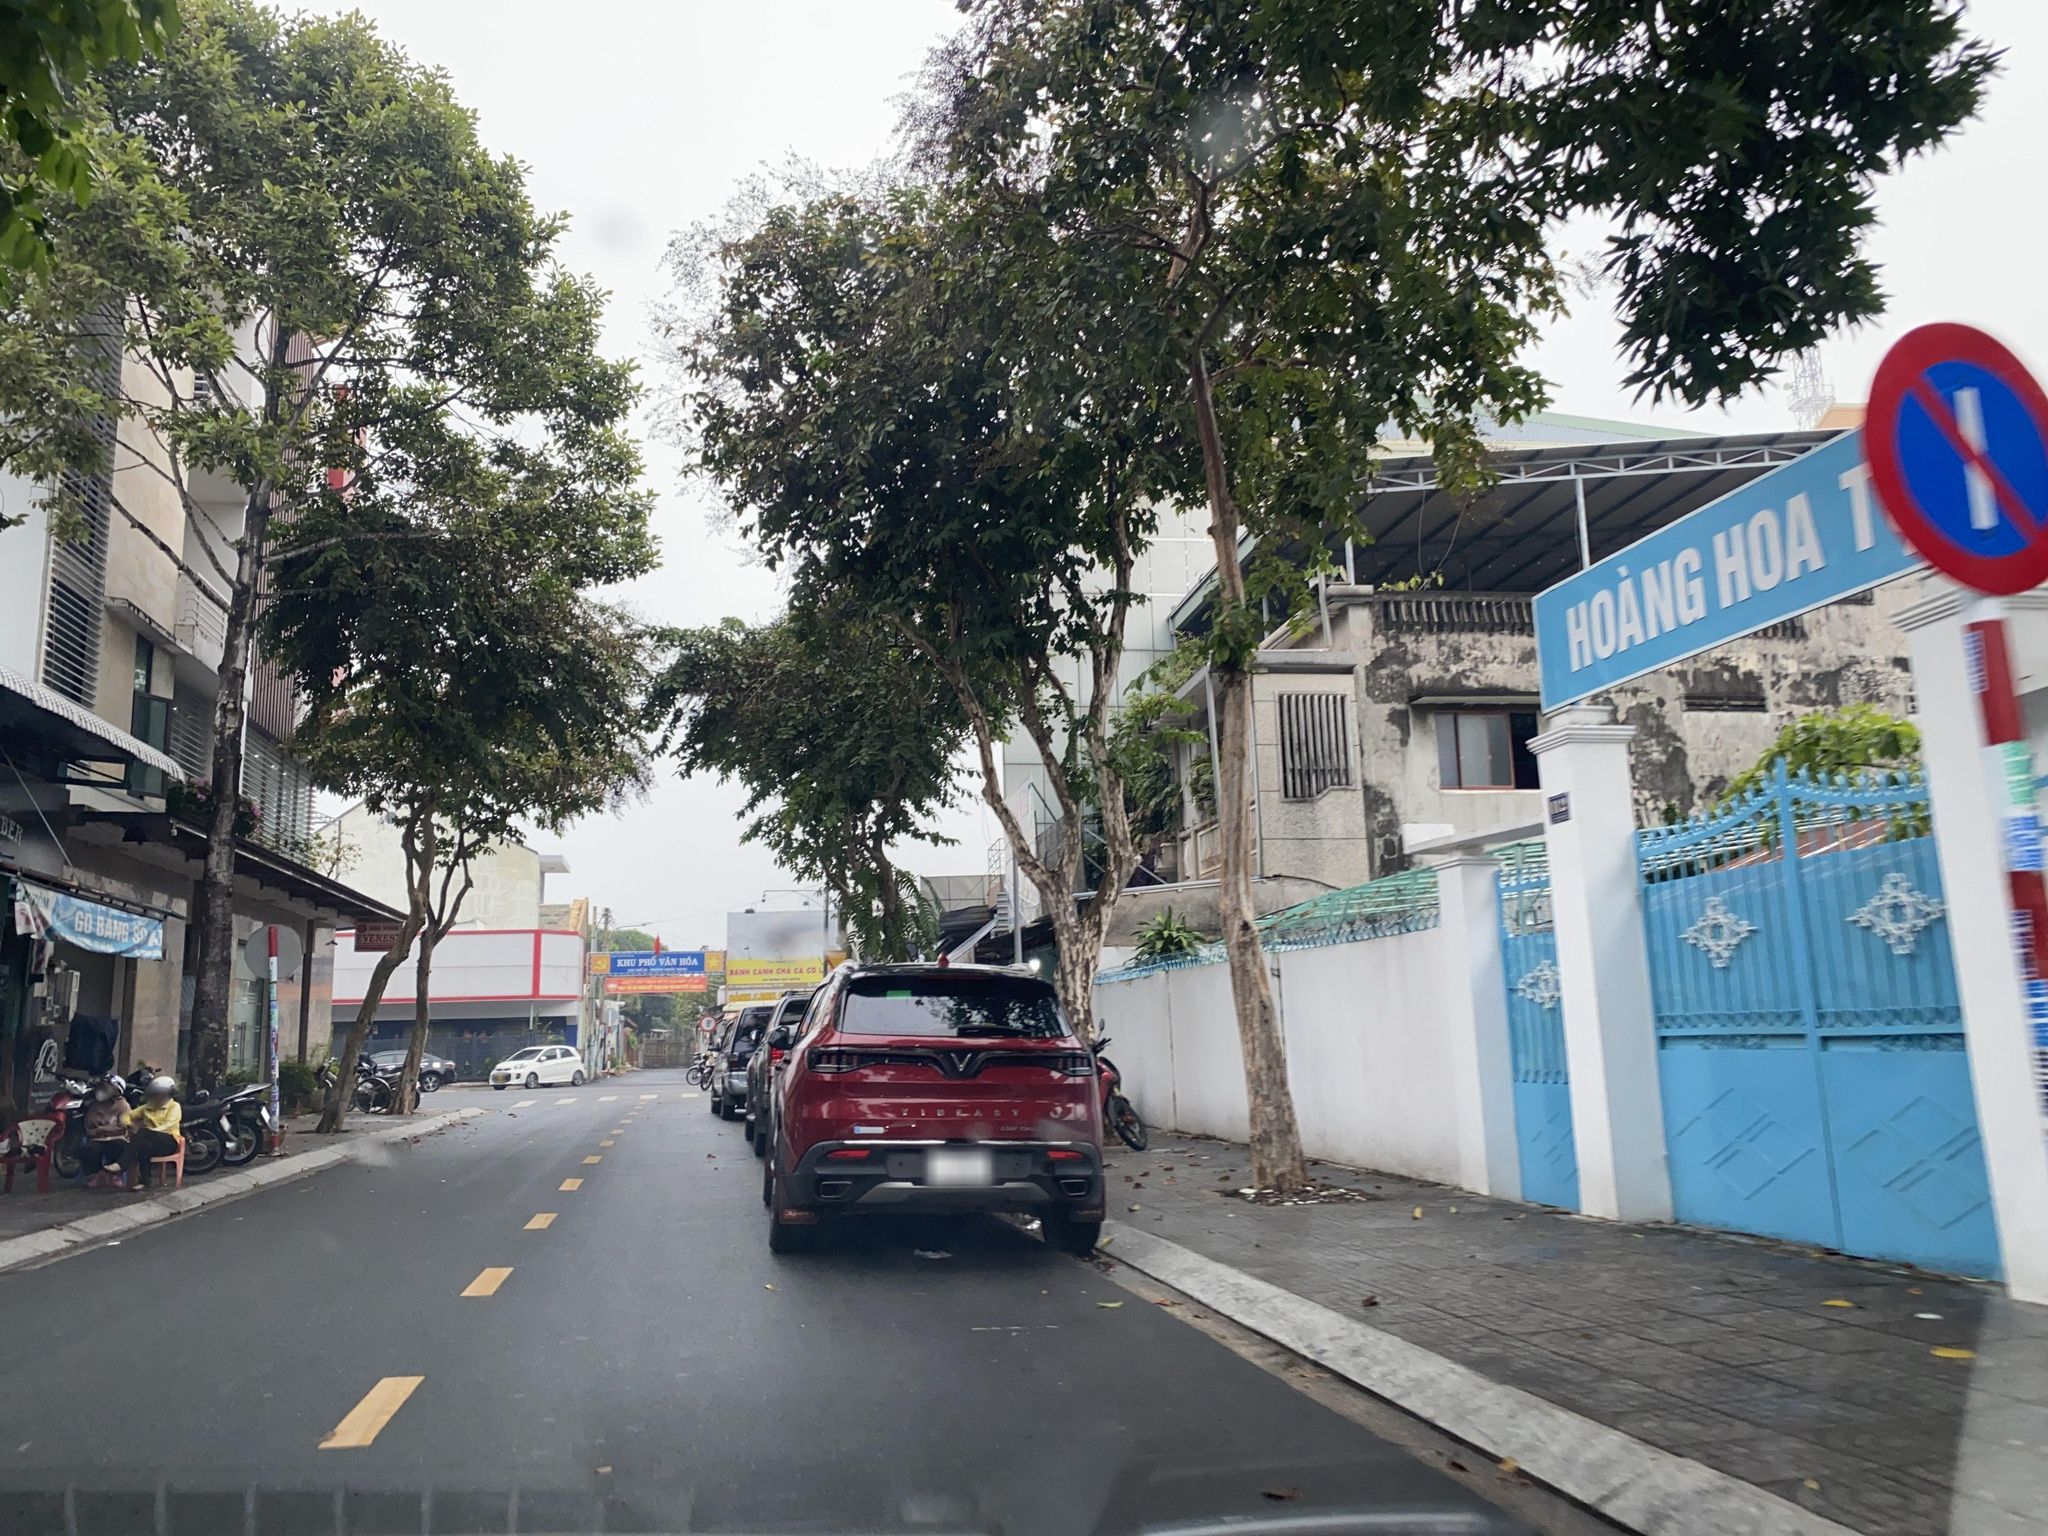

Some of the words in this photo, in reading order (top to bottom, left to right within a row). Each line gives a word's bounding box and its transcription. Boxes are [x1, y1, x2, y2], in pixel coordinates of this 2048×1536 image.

[1566, 546, 1708, 673] HOÀNG
[1712, 492, 1826, 611] HOA
[0, 815, 24, 846] BER
[616, 958, 636, 967] KHU
[638, 955, 656, 967] PHỐ
[679, 956, 698, 966] HÓA
